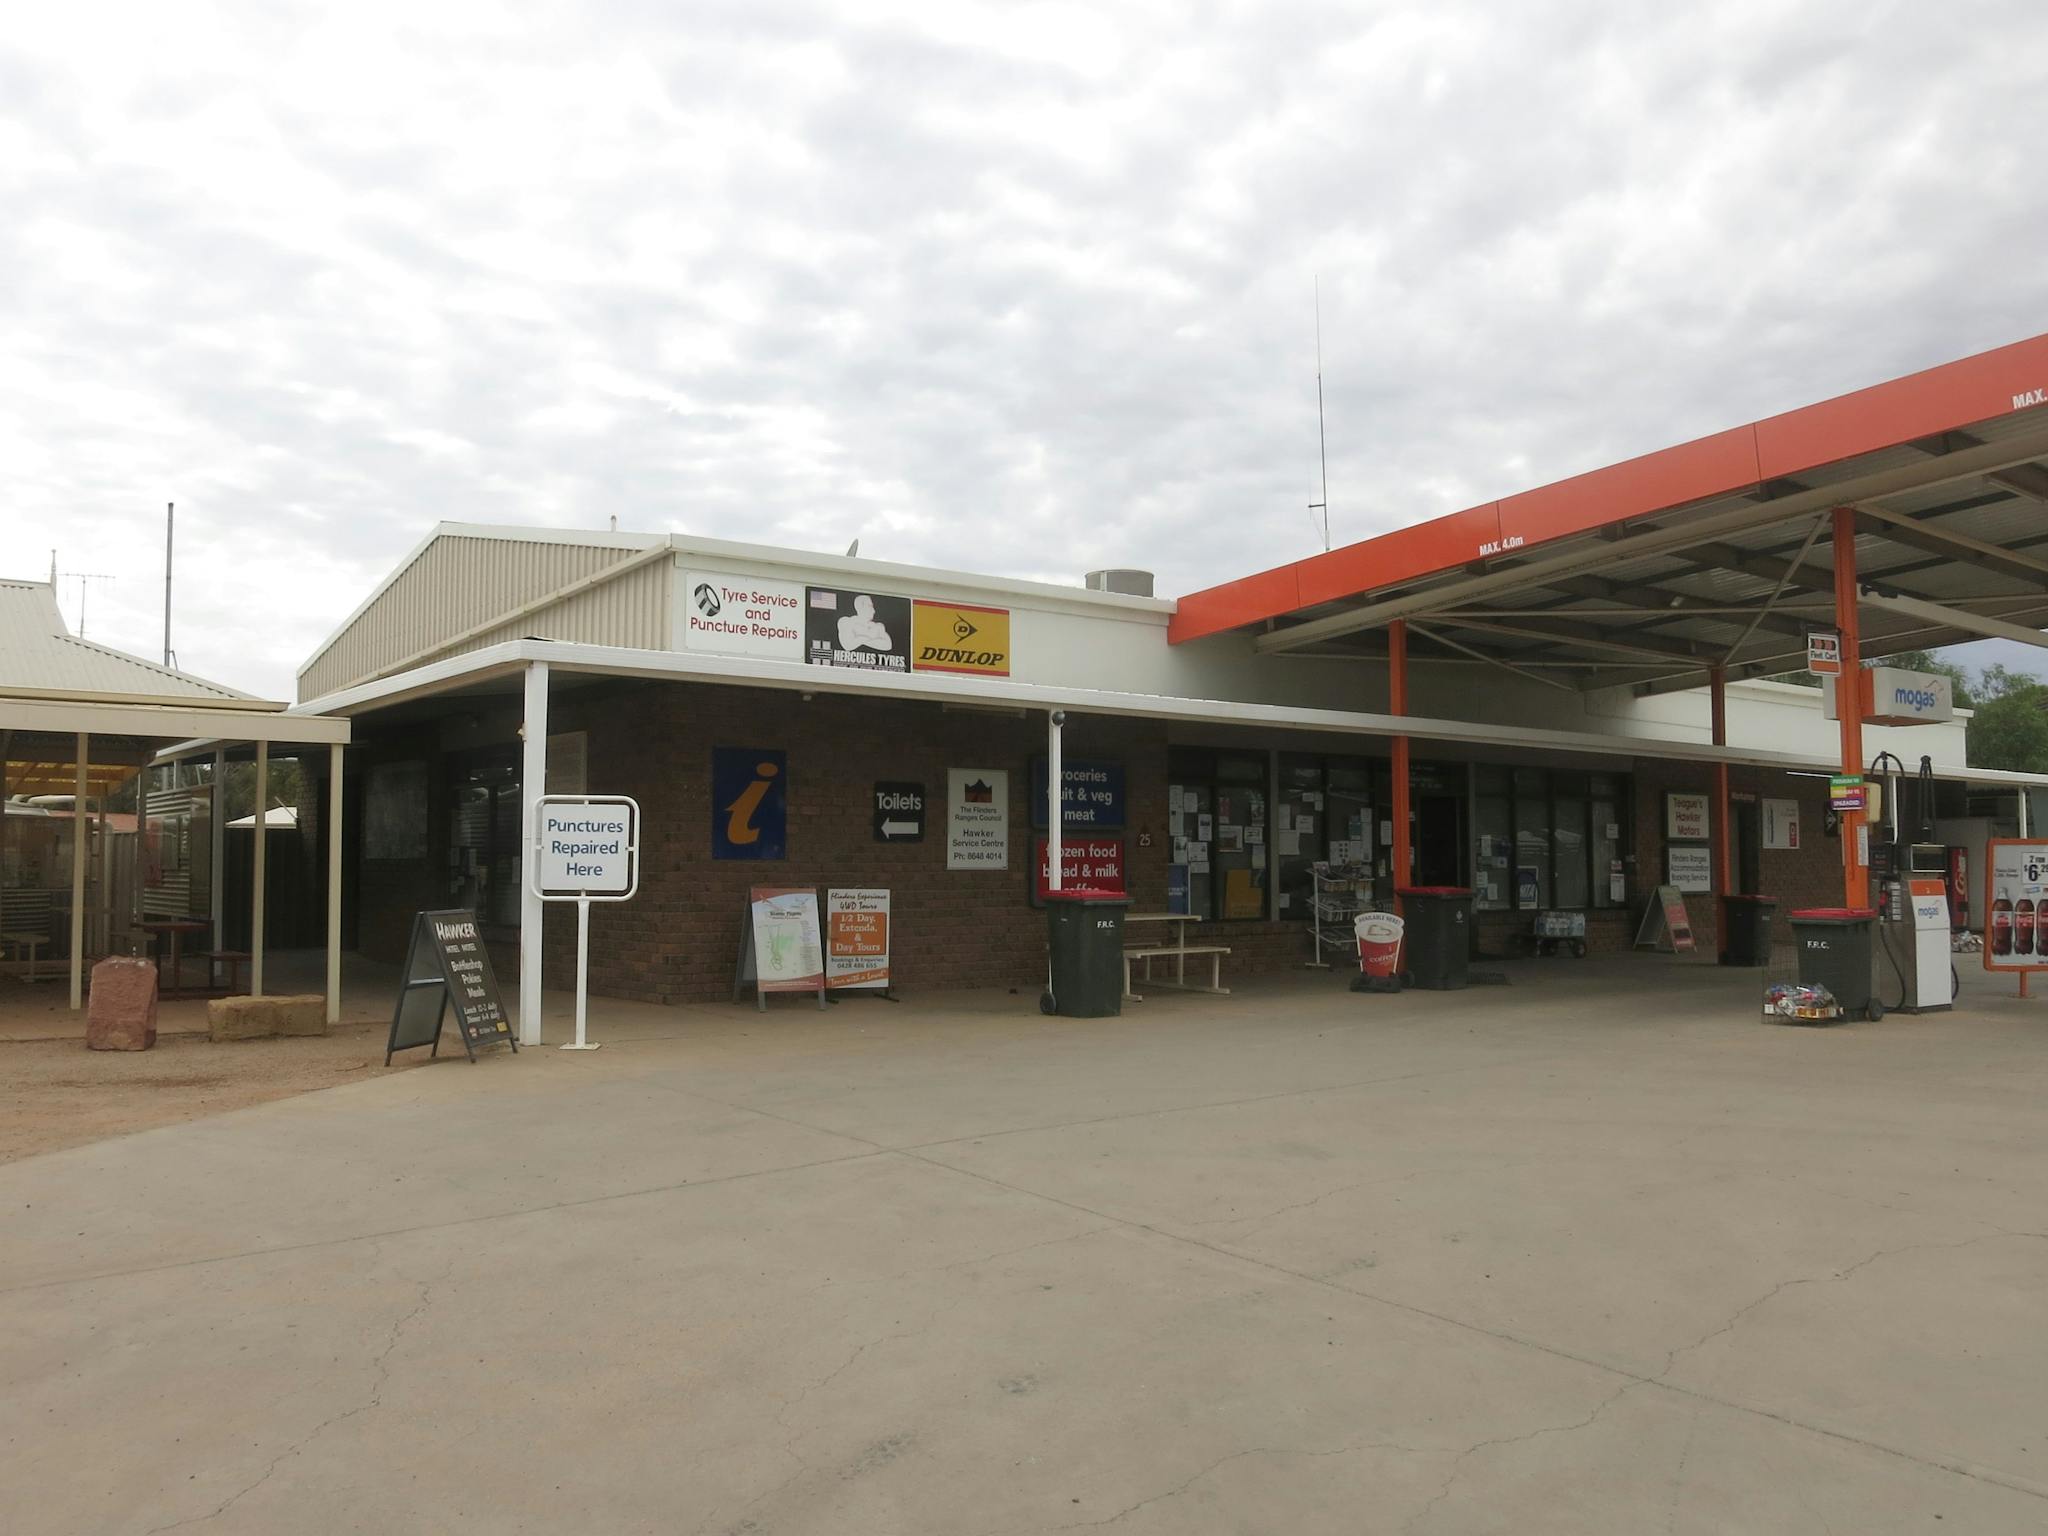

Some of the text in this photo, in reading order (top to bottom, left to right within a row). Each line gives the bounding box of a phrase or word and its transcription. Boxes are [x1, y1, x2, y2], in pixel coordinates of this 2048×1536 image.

[2012, 388, 2046, 409] MAX.
[1479, 536, 1523, 556] MAX. 4.0m
[721, 587, 798, 608] Tyre Service
[745, 609, 771, 621] and
[690, 617, 798, 640] Puncture Repairs
[833, 649, 877, 665] HERCULES
[878, 653, 906, 668] TYRES
[919, 646, 1004, 666] DUNLOP
[1895, 688, 1935, 711] mogas
[1061, 768, 1108, 783] roceries
[876, 792, 922, 811] Toilets
[1046, 786, 1114, 807] fit & veg
[973, 806, 997, 814] Flinders
[1064, 809, 1096, 822] meat
[1675, 811, 1701, 823] Hawker
[954, 814, 978, 822] Ranges
[547, 818, 624, 833] Punctures
[1677, 824, 1700, 836] Motors
[963, 829, 994, 838] Hawker
[1139, 833, 1150, 846] 25
[551, 839, 619, 858] Repaired
[952, 839, 1004, 848] Service Centre
[1046, 842, 1118, 858] fzen food
[566, 862, 603, 876] Here
[1043, 863, 1120, 878] bad & milk
[840, 901, 878, 910] 4WD Tours
[1918, 906, 1939, 919] mogas
[1097, 920, 1115, 929] F.R.C.
[854, 932, 863, 942] &
[836, 942, 881, 952] Day Tours
